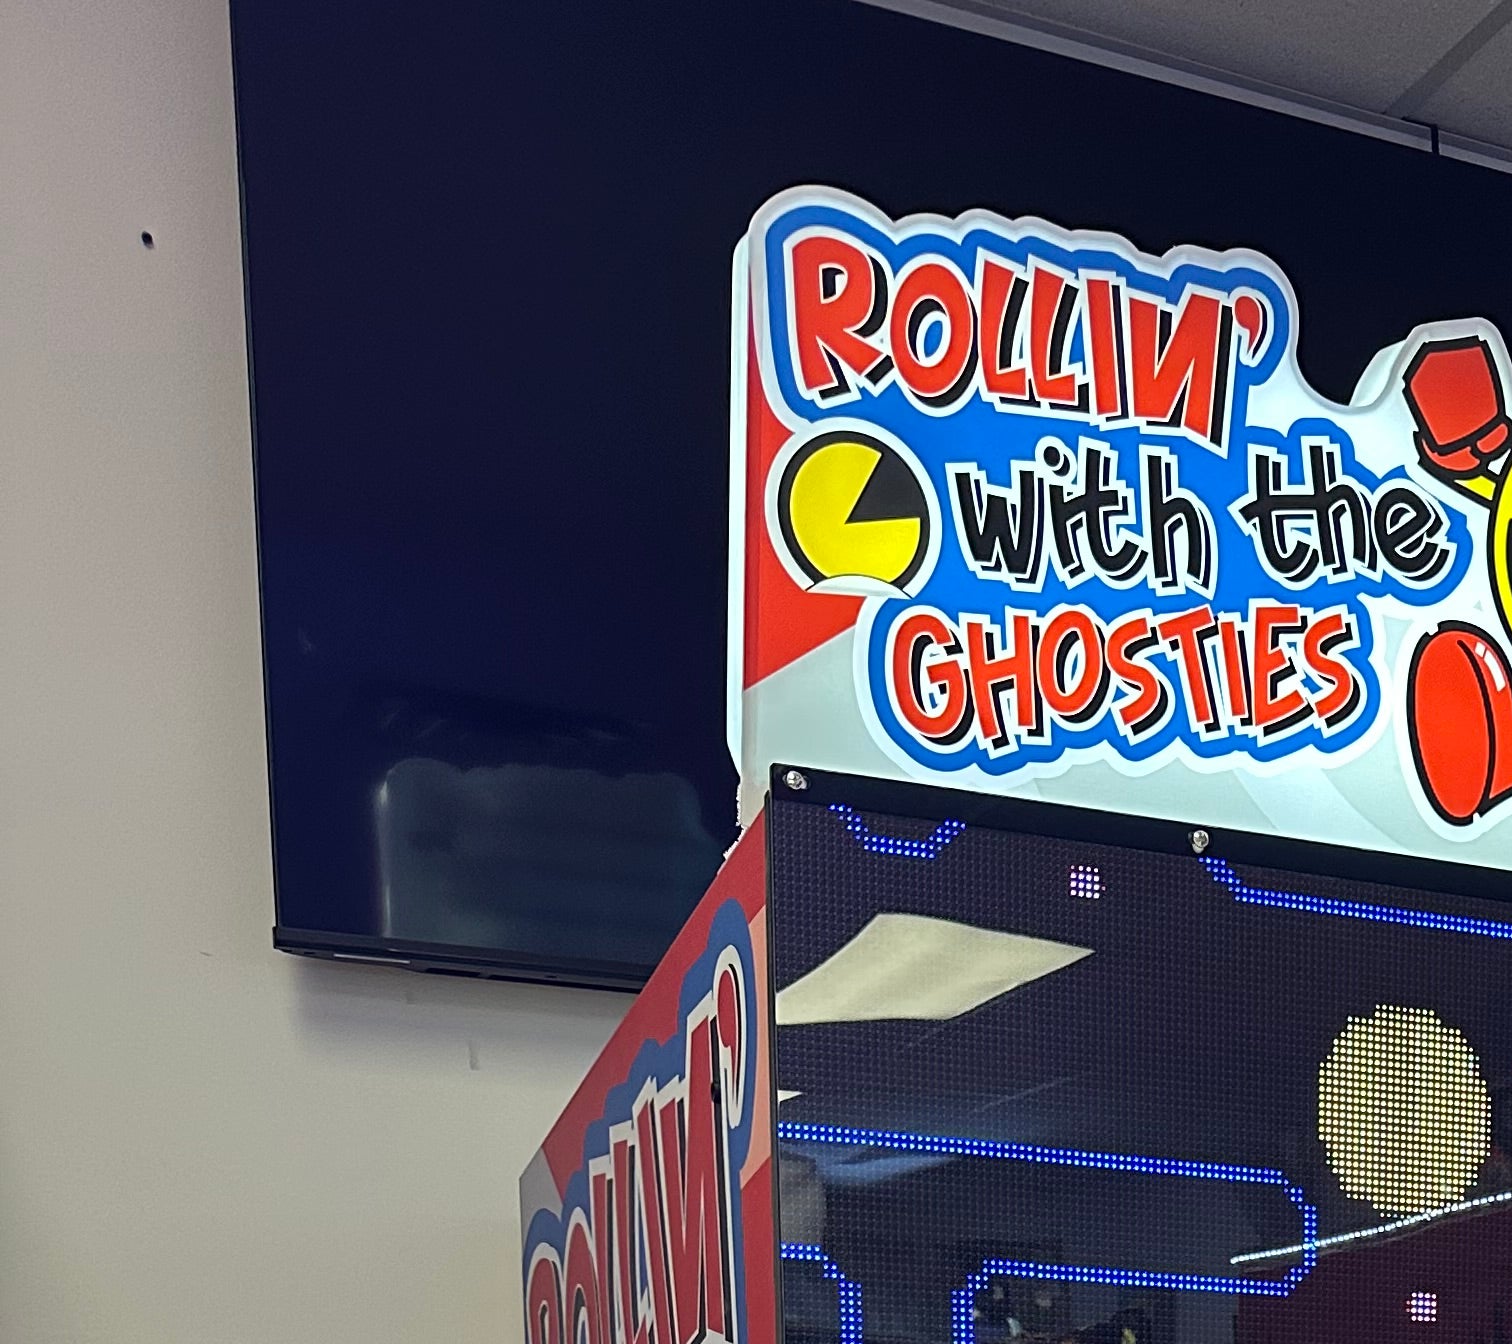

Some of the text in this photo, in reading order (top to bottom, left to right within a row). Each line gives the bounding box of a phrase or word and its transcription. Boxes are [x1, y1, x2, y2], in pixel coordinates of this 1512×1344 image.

[789, 235, 1268, 446] ROLLIN'
[957, 438, 1455, 588] with the
[891, 605, 1361, 748] GHOSTIES
